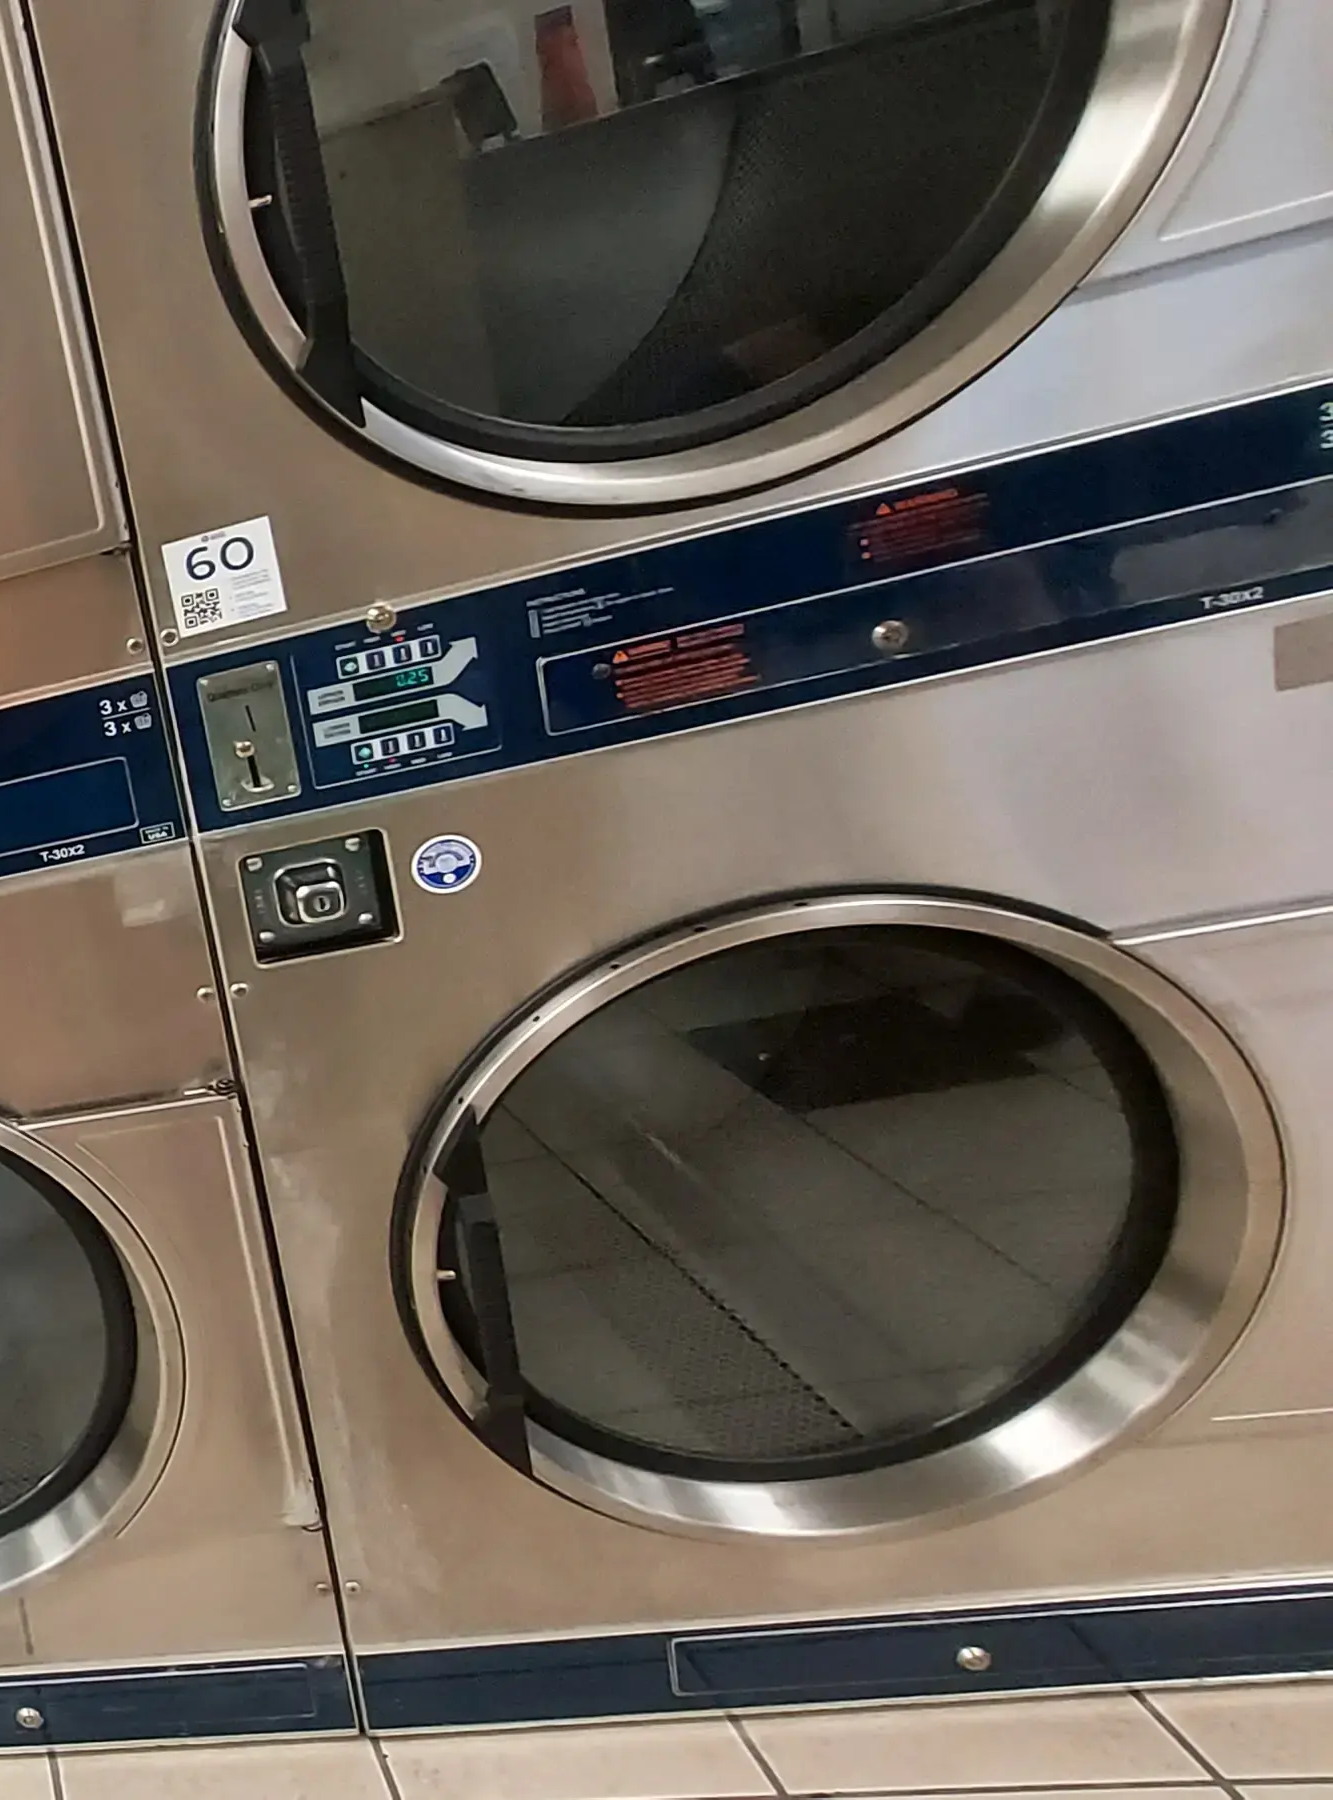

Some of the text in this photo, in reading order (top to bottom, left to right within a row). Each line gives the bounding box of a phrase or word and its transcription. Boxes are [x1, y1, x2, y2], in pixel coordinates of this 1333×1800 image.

[186, 536, 254, 581] 60
[99, 699, 113, 715] 3
[104, 721, 118, 737] 3
[39, 844, 86, 862] T-30X2
